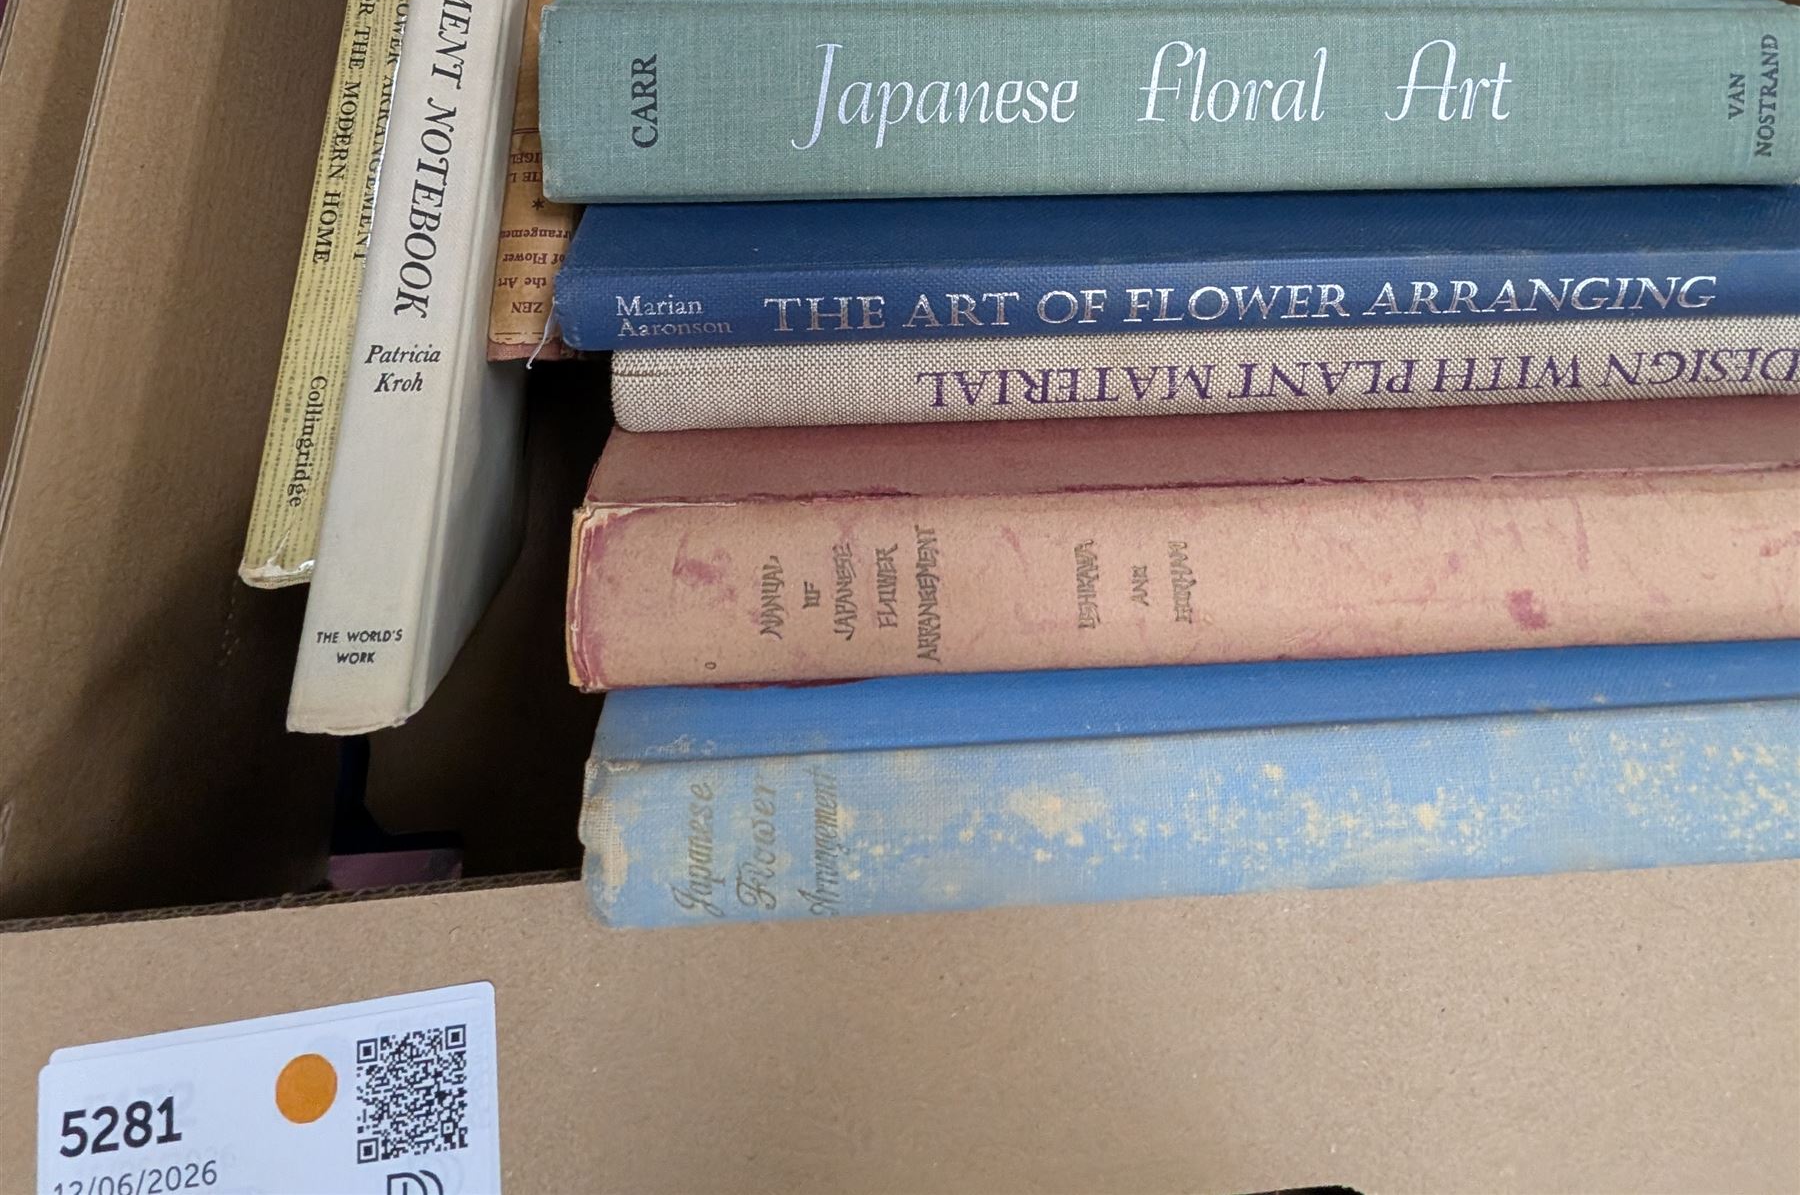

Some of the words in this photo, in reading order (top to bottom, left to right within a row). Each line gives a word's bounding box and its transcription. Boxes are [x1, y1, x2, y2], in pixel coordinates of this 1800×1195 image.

[347, 25, 371, 71] THE
[629, 53, 658, 149] CARR
[791, 42, 1080, 150] Japanese
[1136, 39, 1328, 123] Floral
[1384, 38, 1513, 122] Art
[1728, 71, 1746, 121] VAN
[1754, 33, 1781, 158] NOSTRAND
[326, 80, 362, 183] MODERN
[312, 189, 342, 265] HOME
[393, 97, 458, 320] NOTEBOOK
[502, 252, 548, 266] Flower
[497, 276, 519, 289] Art
[524, 276, 547, 289] the
[615, 293, 704, 318] Marian
[763, 294, 886, 333] THE
[901, 291, 1021, 329] ART
[1035, 288, 1108, 325] OF
[1122, 281, 1350, 324] FLOWER
[1362, 275, 1718, 317] ARRANGING
[510, 301, 544, 314] ZEN
[616, 315, 734, 339] Aaronson
[363, 343, 441, 365] Patricia
[1431, 352, 1581, 393] WITH
[1595, 345, 1800, 391] DESIGN
[373, 371, 424, 394] Kroh
[916, 362, 1213, 408] MATERIAL
[1229, 358, 1415, 399] PLANT
[286, 375, 328, 508] Collingridge
[759, 554, 784, 640] MANUAL
[832, 542, 858, 641] JAPANESE
[315, 629, 339, 645] THE
[346, 628, 403, 644] WORLD'S
[336, 651, 376, 665] WORK
[671, 781, 726, 918] Japanese
[735, 774, 778, 911] Flower
[59, 1095, 183, 1158] 5281
